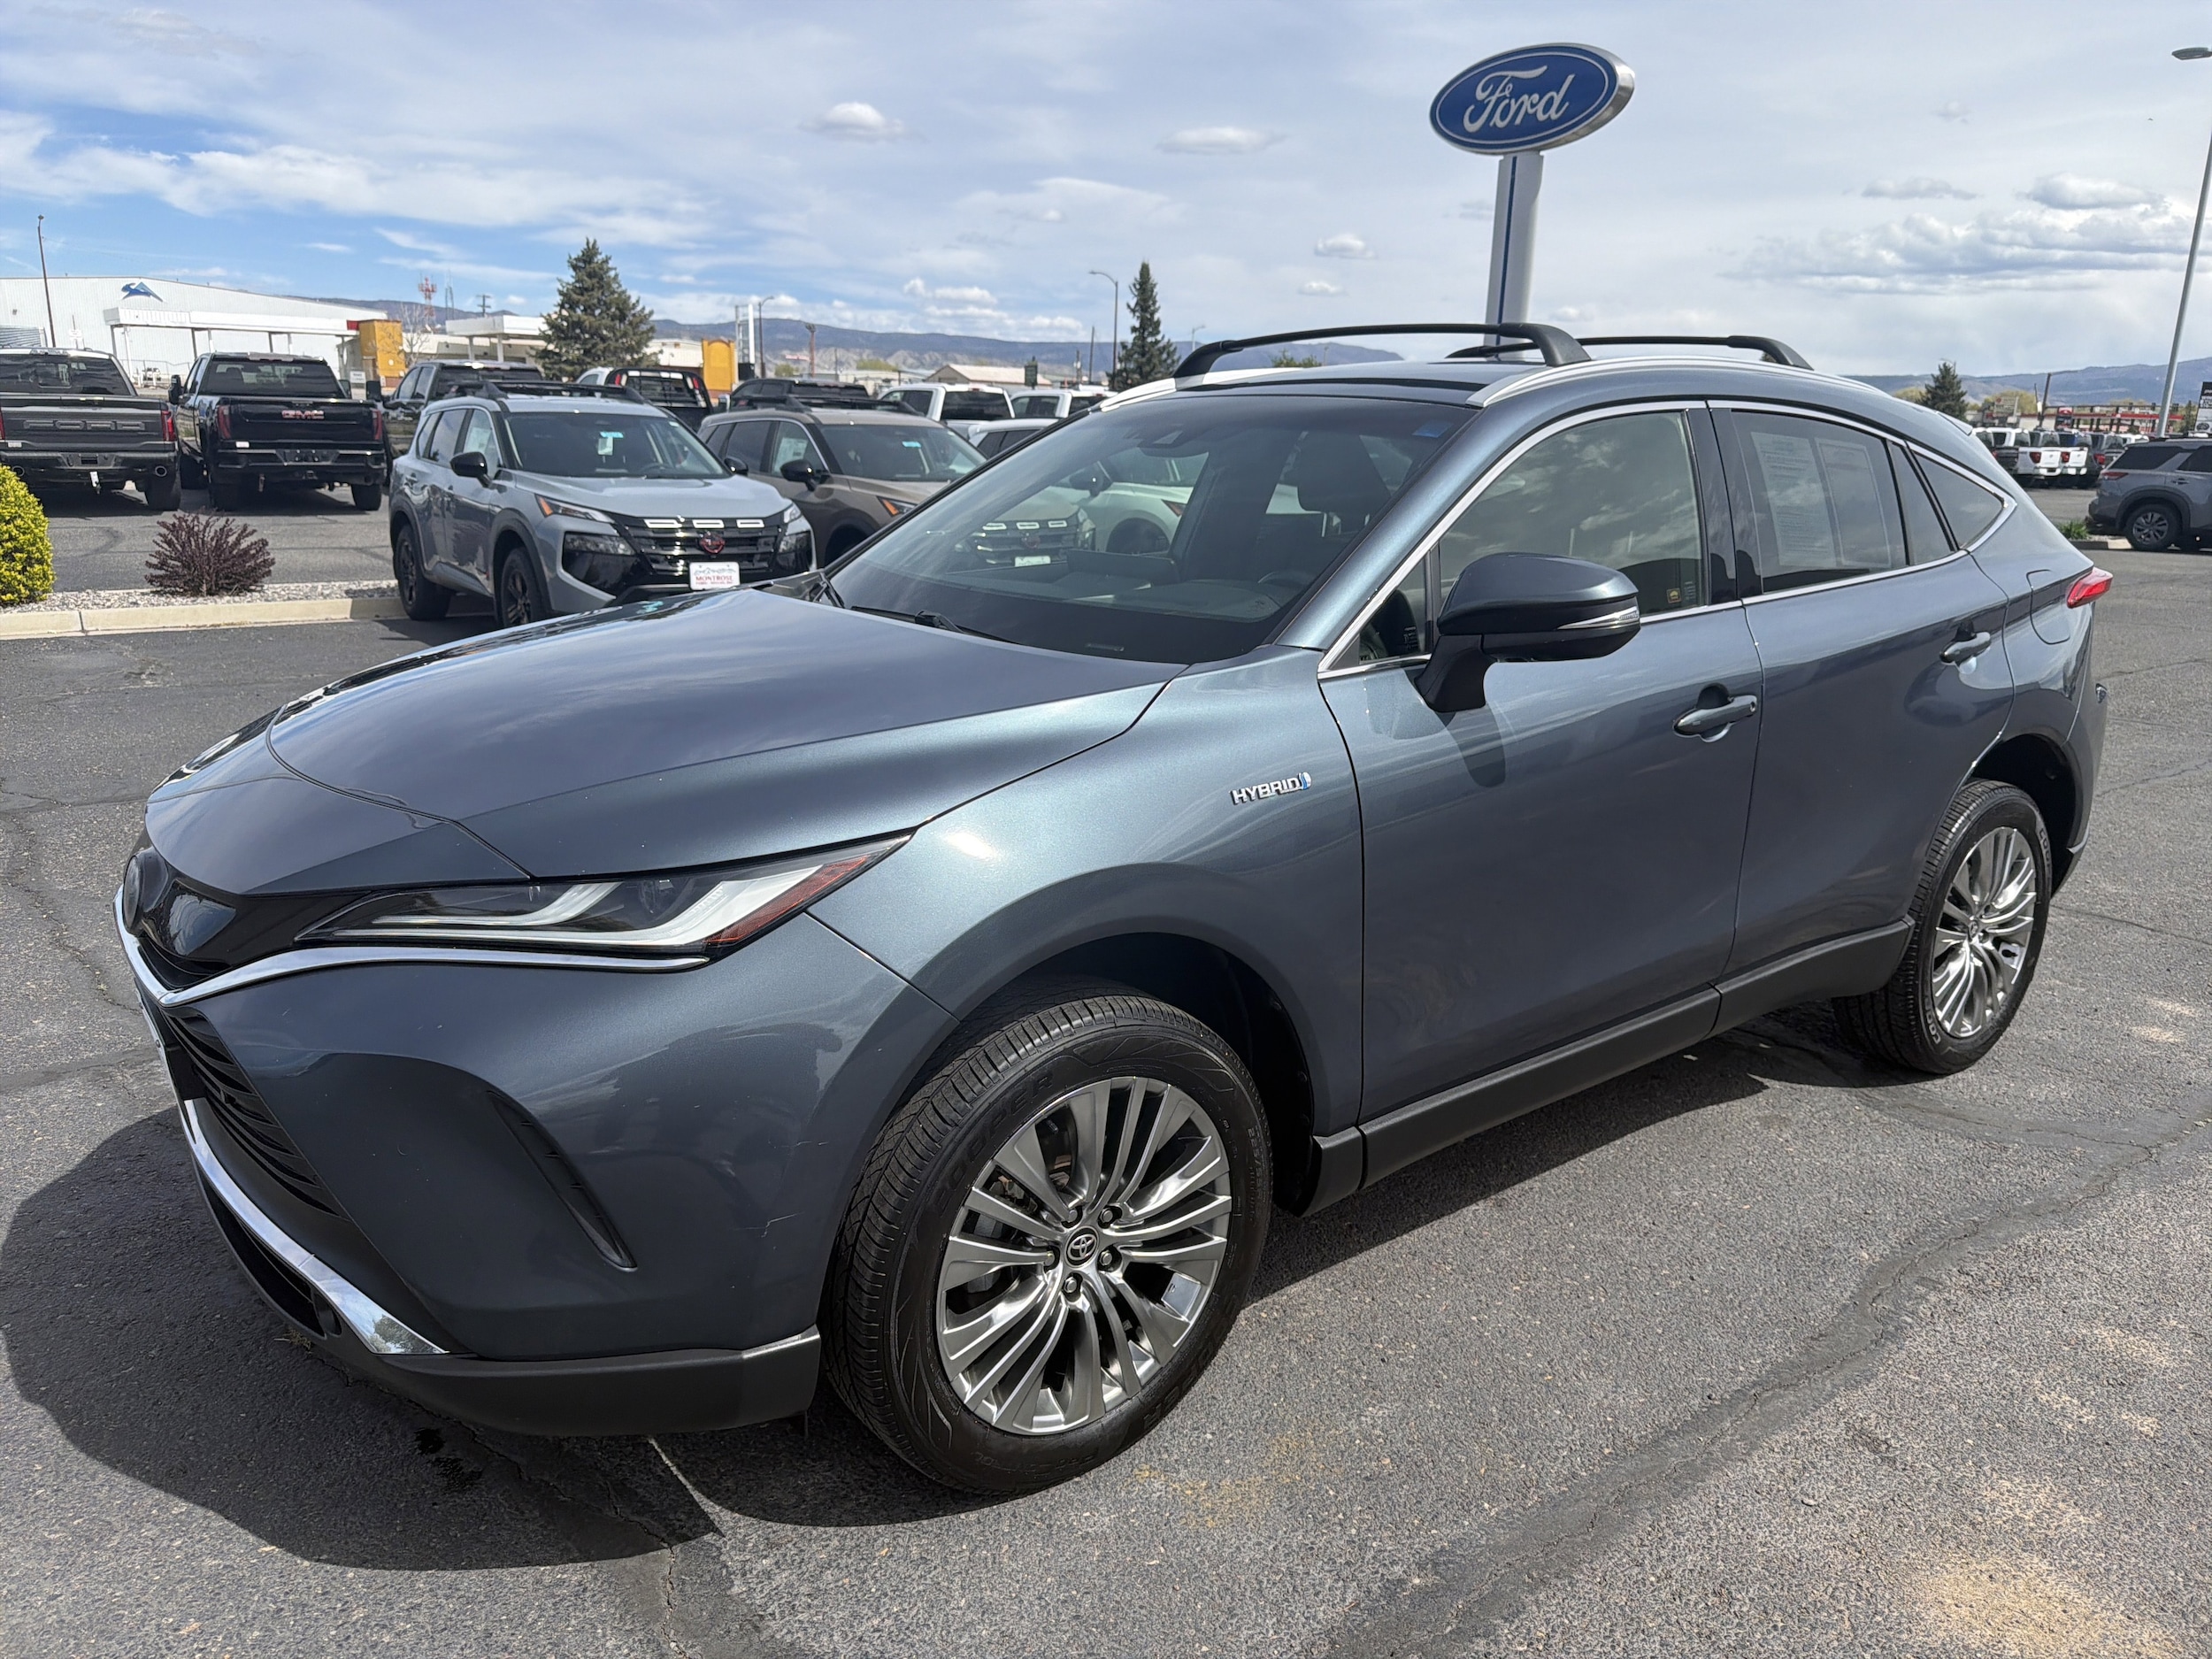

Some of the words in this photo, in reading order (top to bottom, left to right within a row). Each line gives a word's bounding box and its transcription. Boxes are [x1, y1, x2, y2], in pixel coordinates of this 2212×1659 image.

[1463, 65, 1576, 134] Ford
[281, 410, 325, 419] GMC
[23, 419, 146, 431] FORD
[1230, 776, 1302, 805] HYBRID
